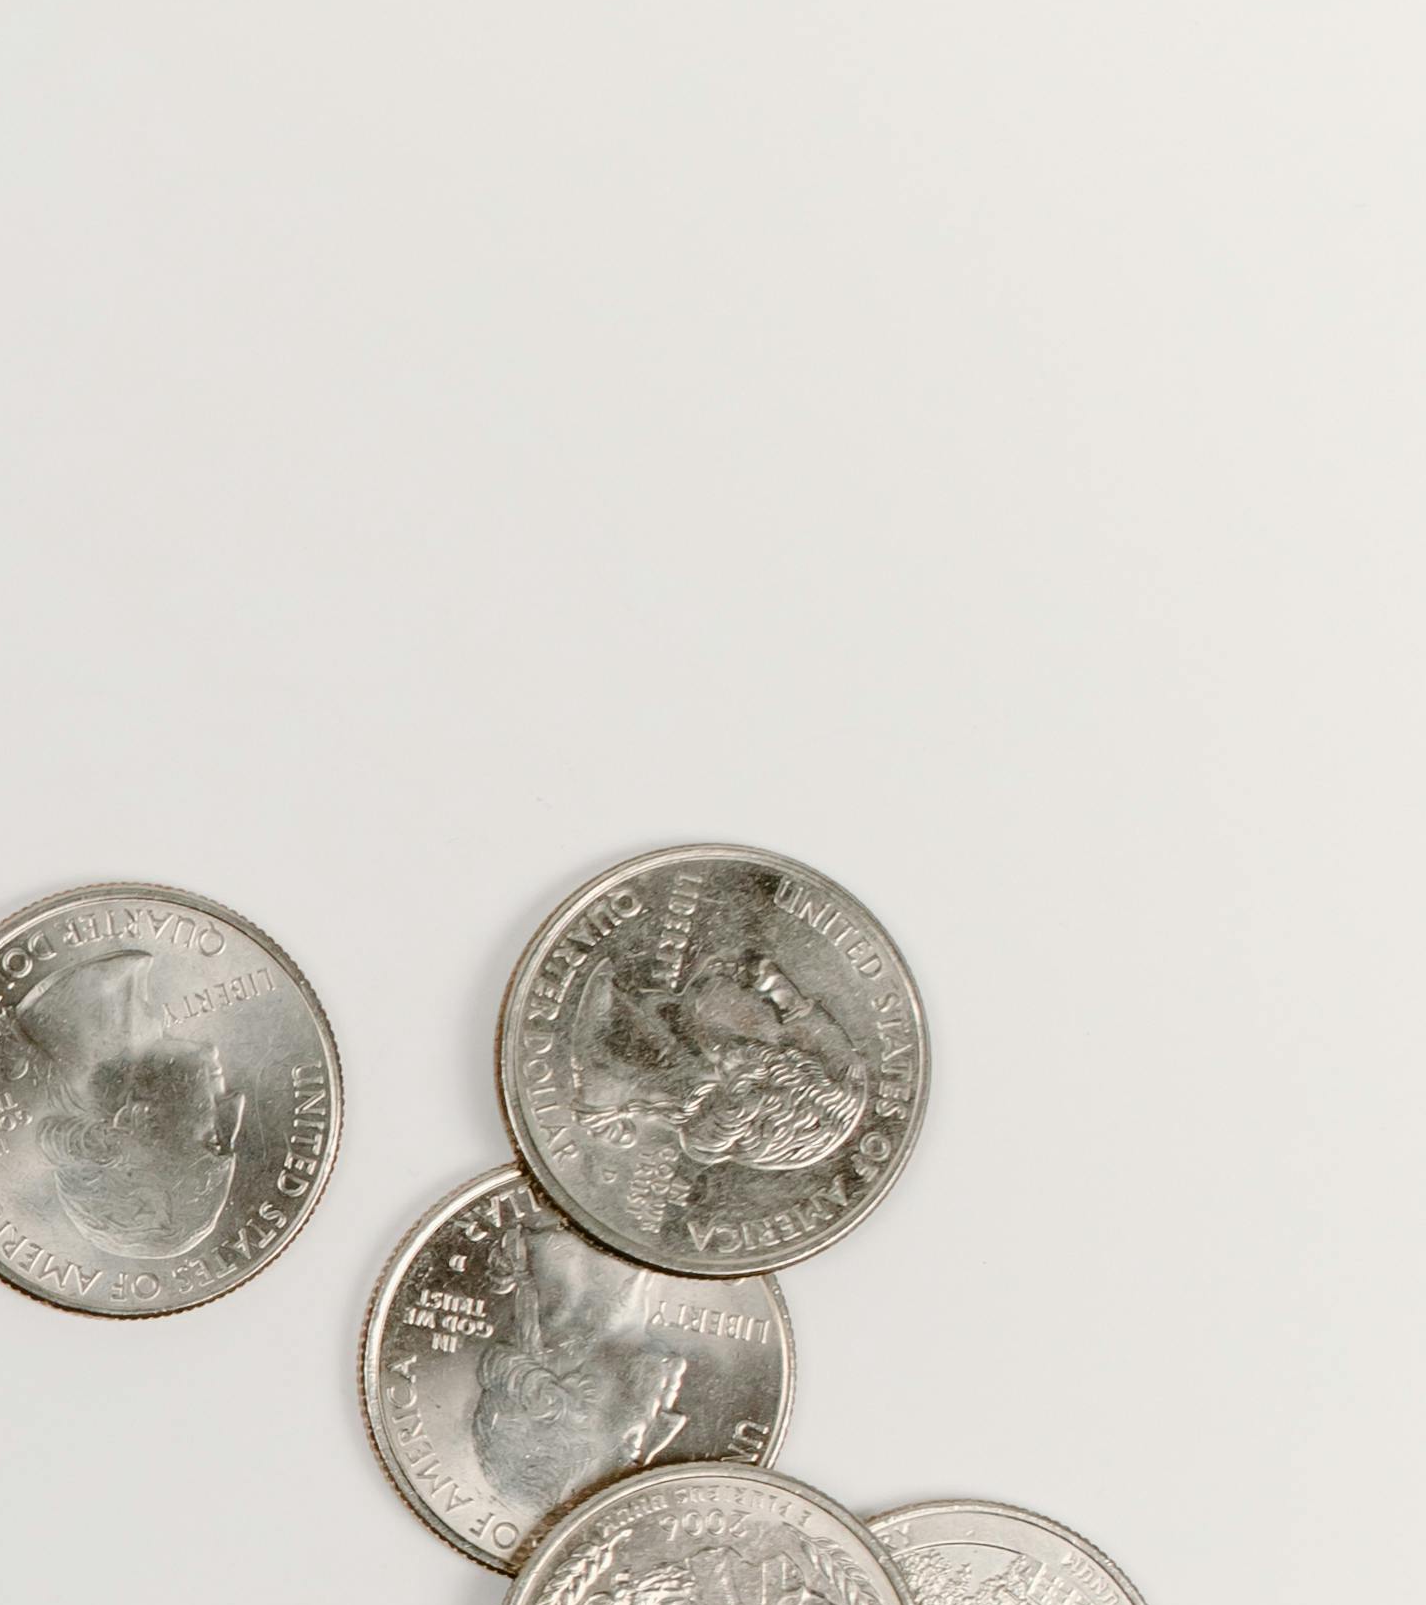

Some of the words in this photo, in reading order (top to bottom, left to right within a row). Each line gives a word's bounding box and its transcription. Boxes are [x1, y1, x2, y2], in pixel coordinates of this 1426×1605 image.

[63, 908, 226, 957] QUARTER
[773, 879, 884, 979] UNITED
[162, 967, 277, 1029] LIBERTY
[870, 992, 914, 1121] STATES
[524, 1030, 582, 1164] DOLLAR
[277, 1061, 327, 1198] UNITED
[853, 1131, 892, 1185] OF
[686, 1172, 852, 1254] AMERICA
[110, 1273, 161, 1303] OF
[650, 1300, 771, 1344] LIBERTY
[385, 1354, 475, 1514] AMERICA
[468, 1516, 519, 1551] OF
[659, 1508, 752, 1542] 2006
